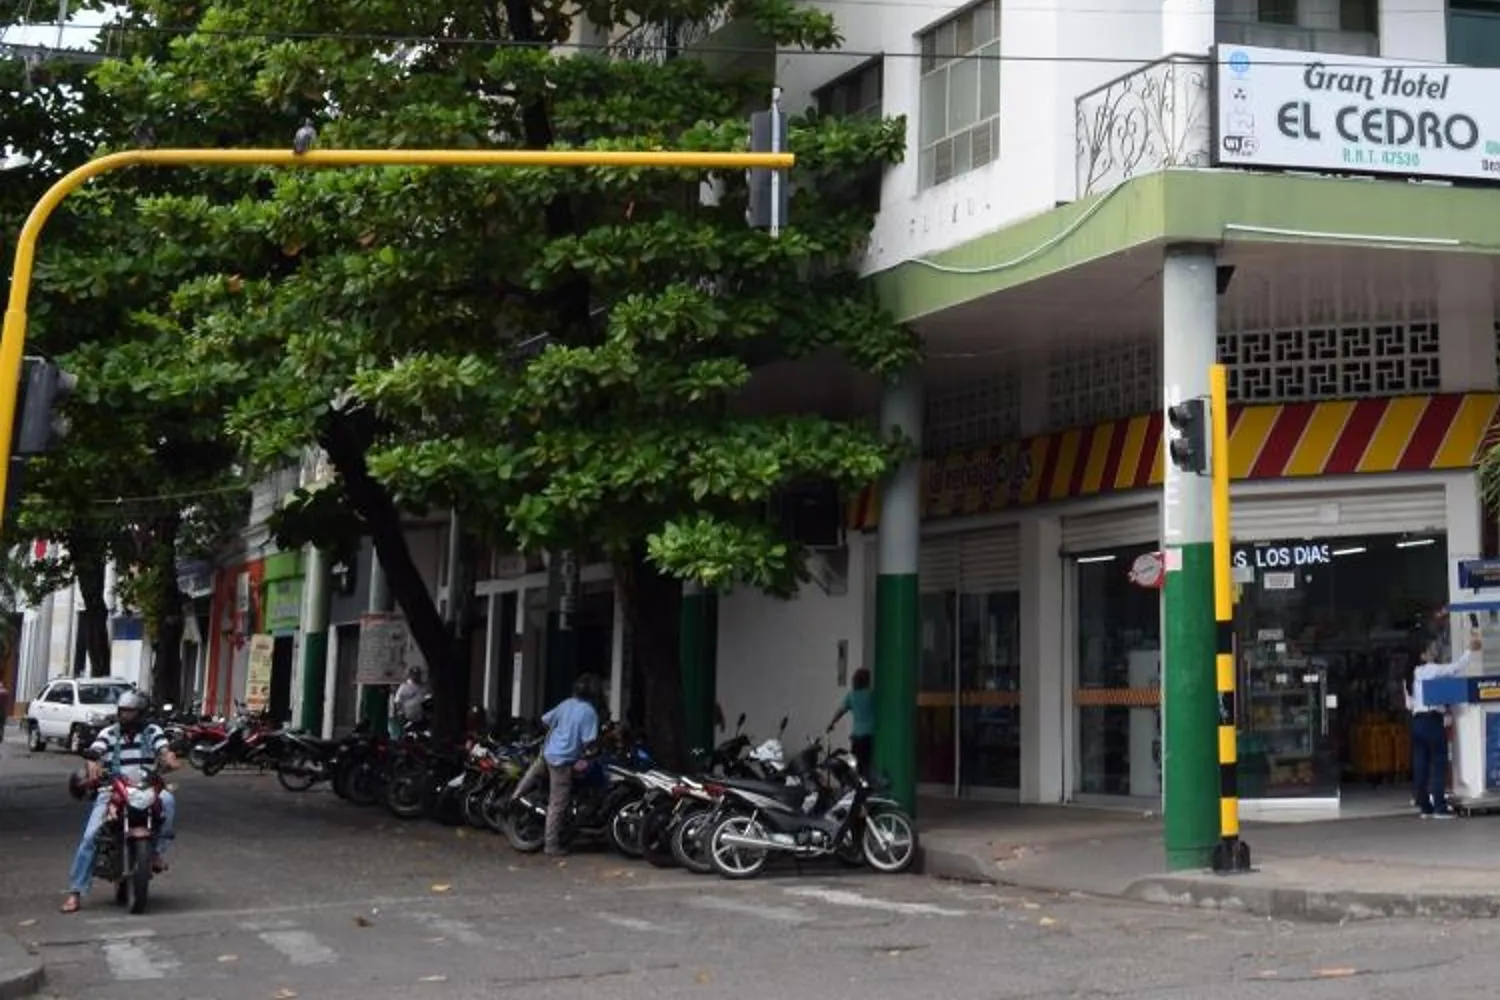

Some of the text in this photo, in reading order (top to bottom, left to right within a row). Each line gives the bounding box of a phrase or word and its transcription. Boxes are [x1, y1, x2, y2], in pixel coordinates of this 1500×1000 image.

[1303, 62, 1450, 100] Gran Hotel
[1277, 101, 1321, 140] EL
[1336, 106, 1479, 150] CEDRO
[1256, 547, 1290, 567] LOS
[1294, 545, 1330, 565] DIAS
